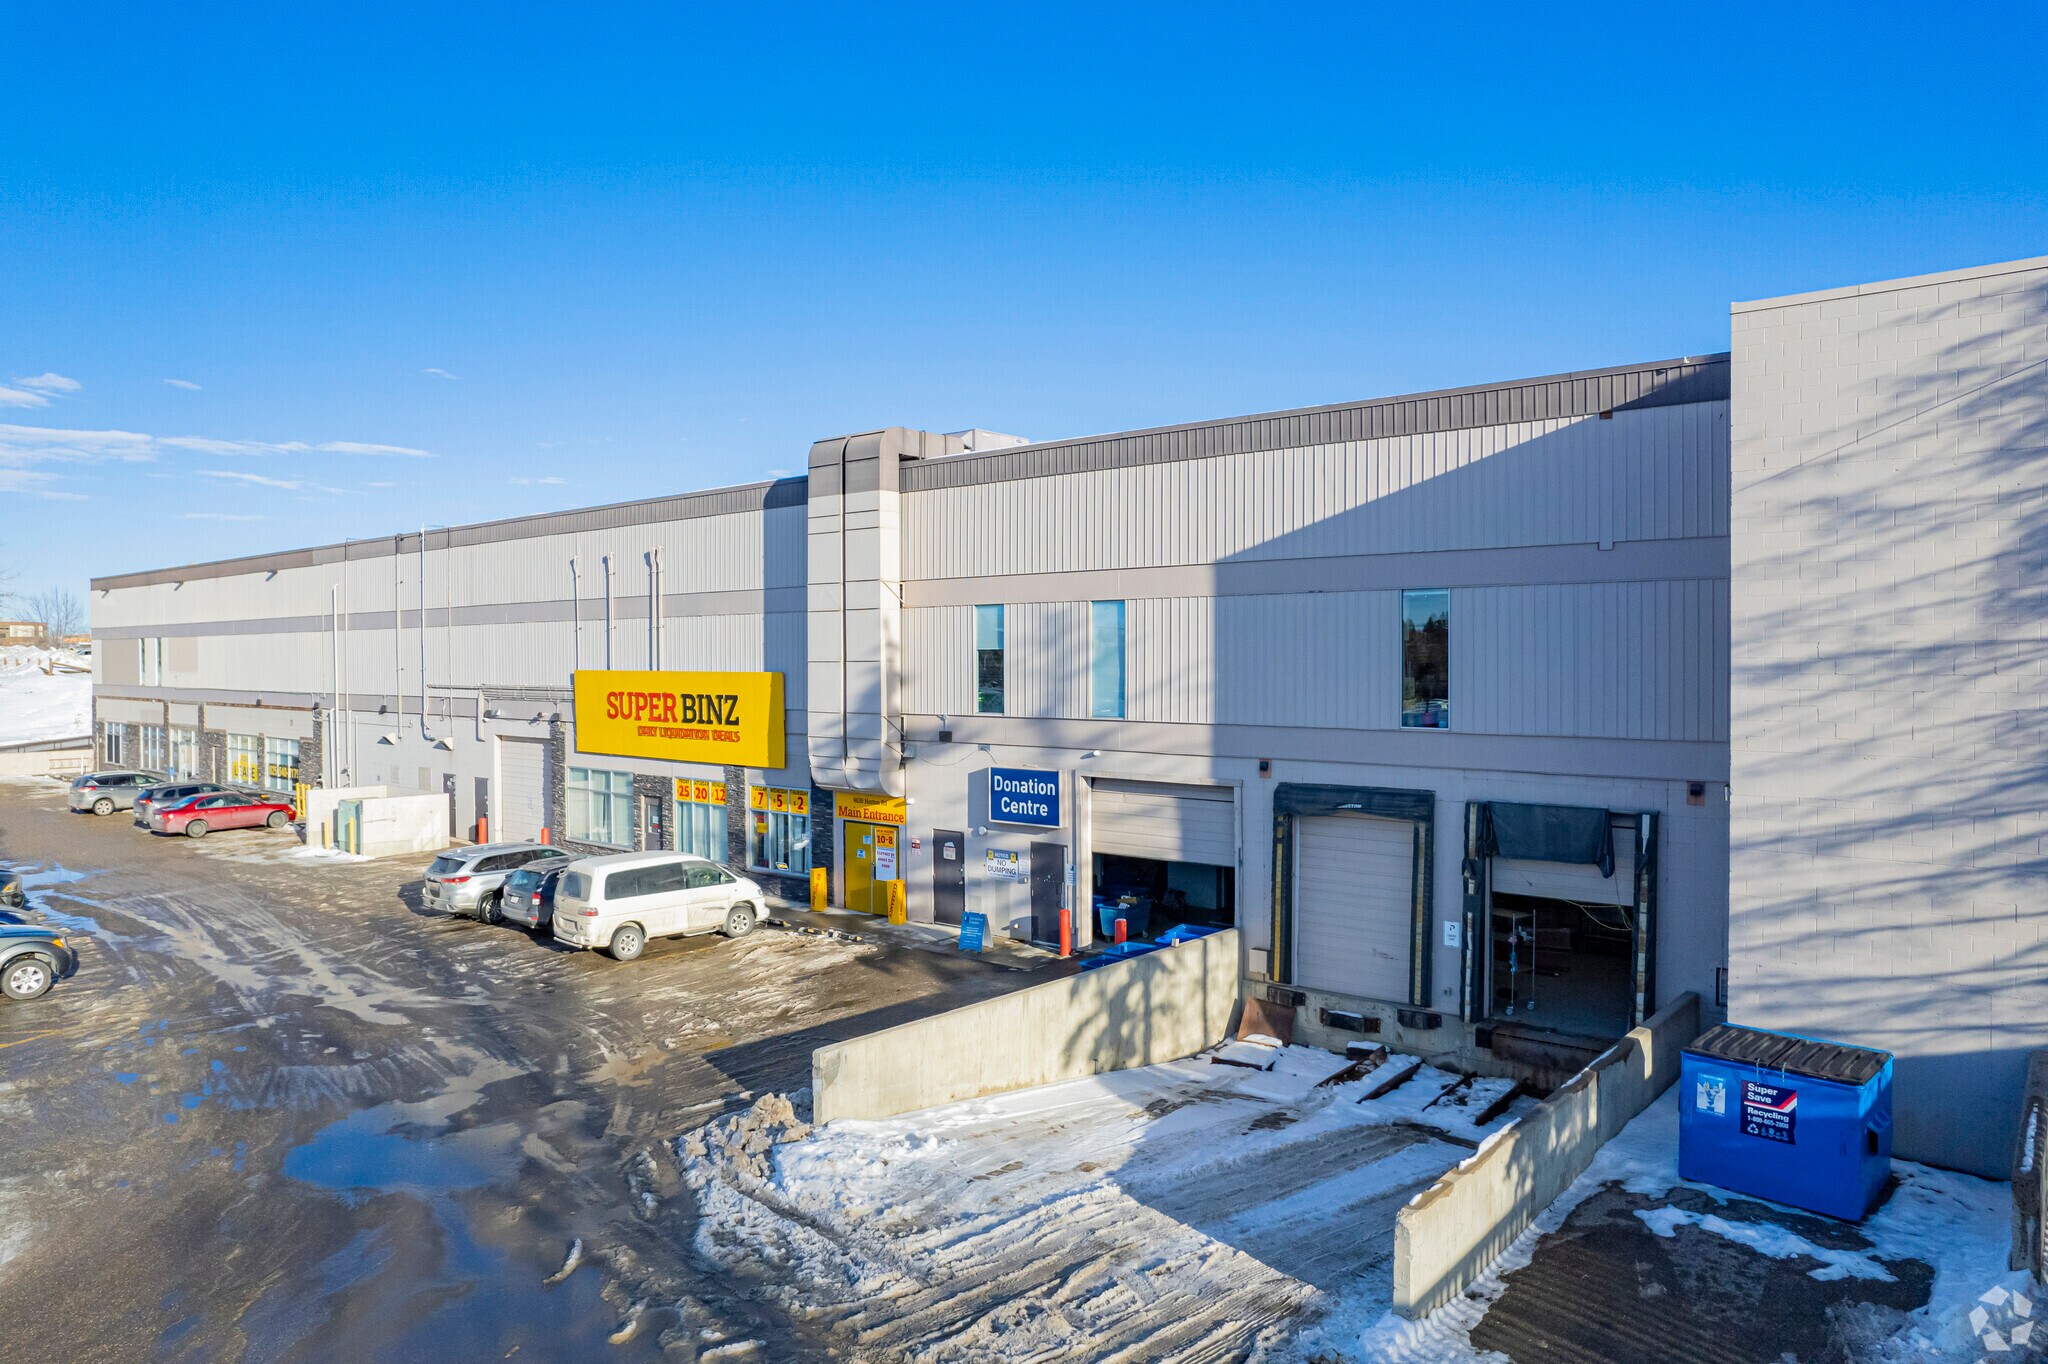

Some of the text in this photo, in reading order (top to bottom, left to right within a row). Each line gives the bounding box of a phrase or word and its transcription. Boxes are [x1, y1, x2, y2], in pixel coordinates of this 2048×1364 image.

[606, 691, 740, 726] SUPER BINZ
[679, 785, 690, 797] 25
[994, 775, 1056, 796] Donation
[695, 787, 708, 800] 20
[715, 788, 726, 802] 12
[1001, 796, 1048, 817] Centre
[838, 805, 905, 823] Main Entrance
[987, 865, 1017, 876] DUMPING
[1747, 1083, 1778, 1096] Super
[1747, 1092, 1772, 1104] Save
[1747, 1106, 1789, 1123] Recycling
